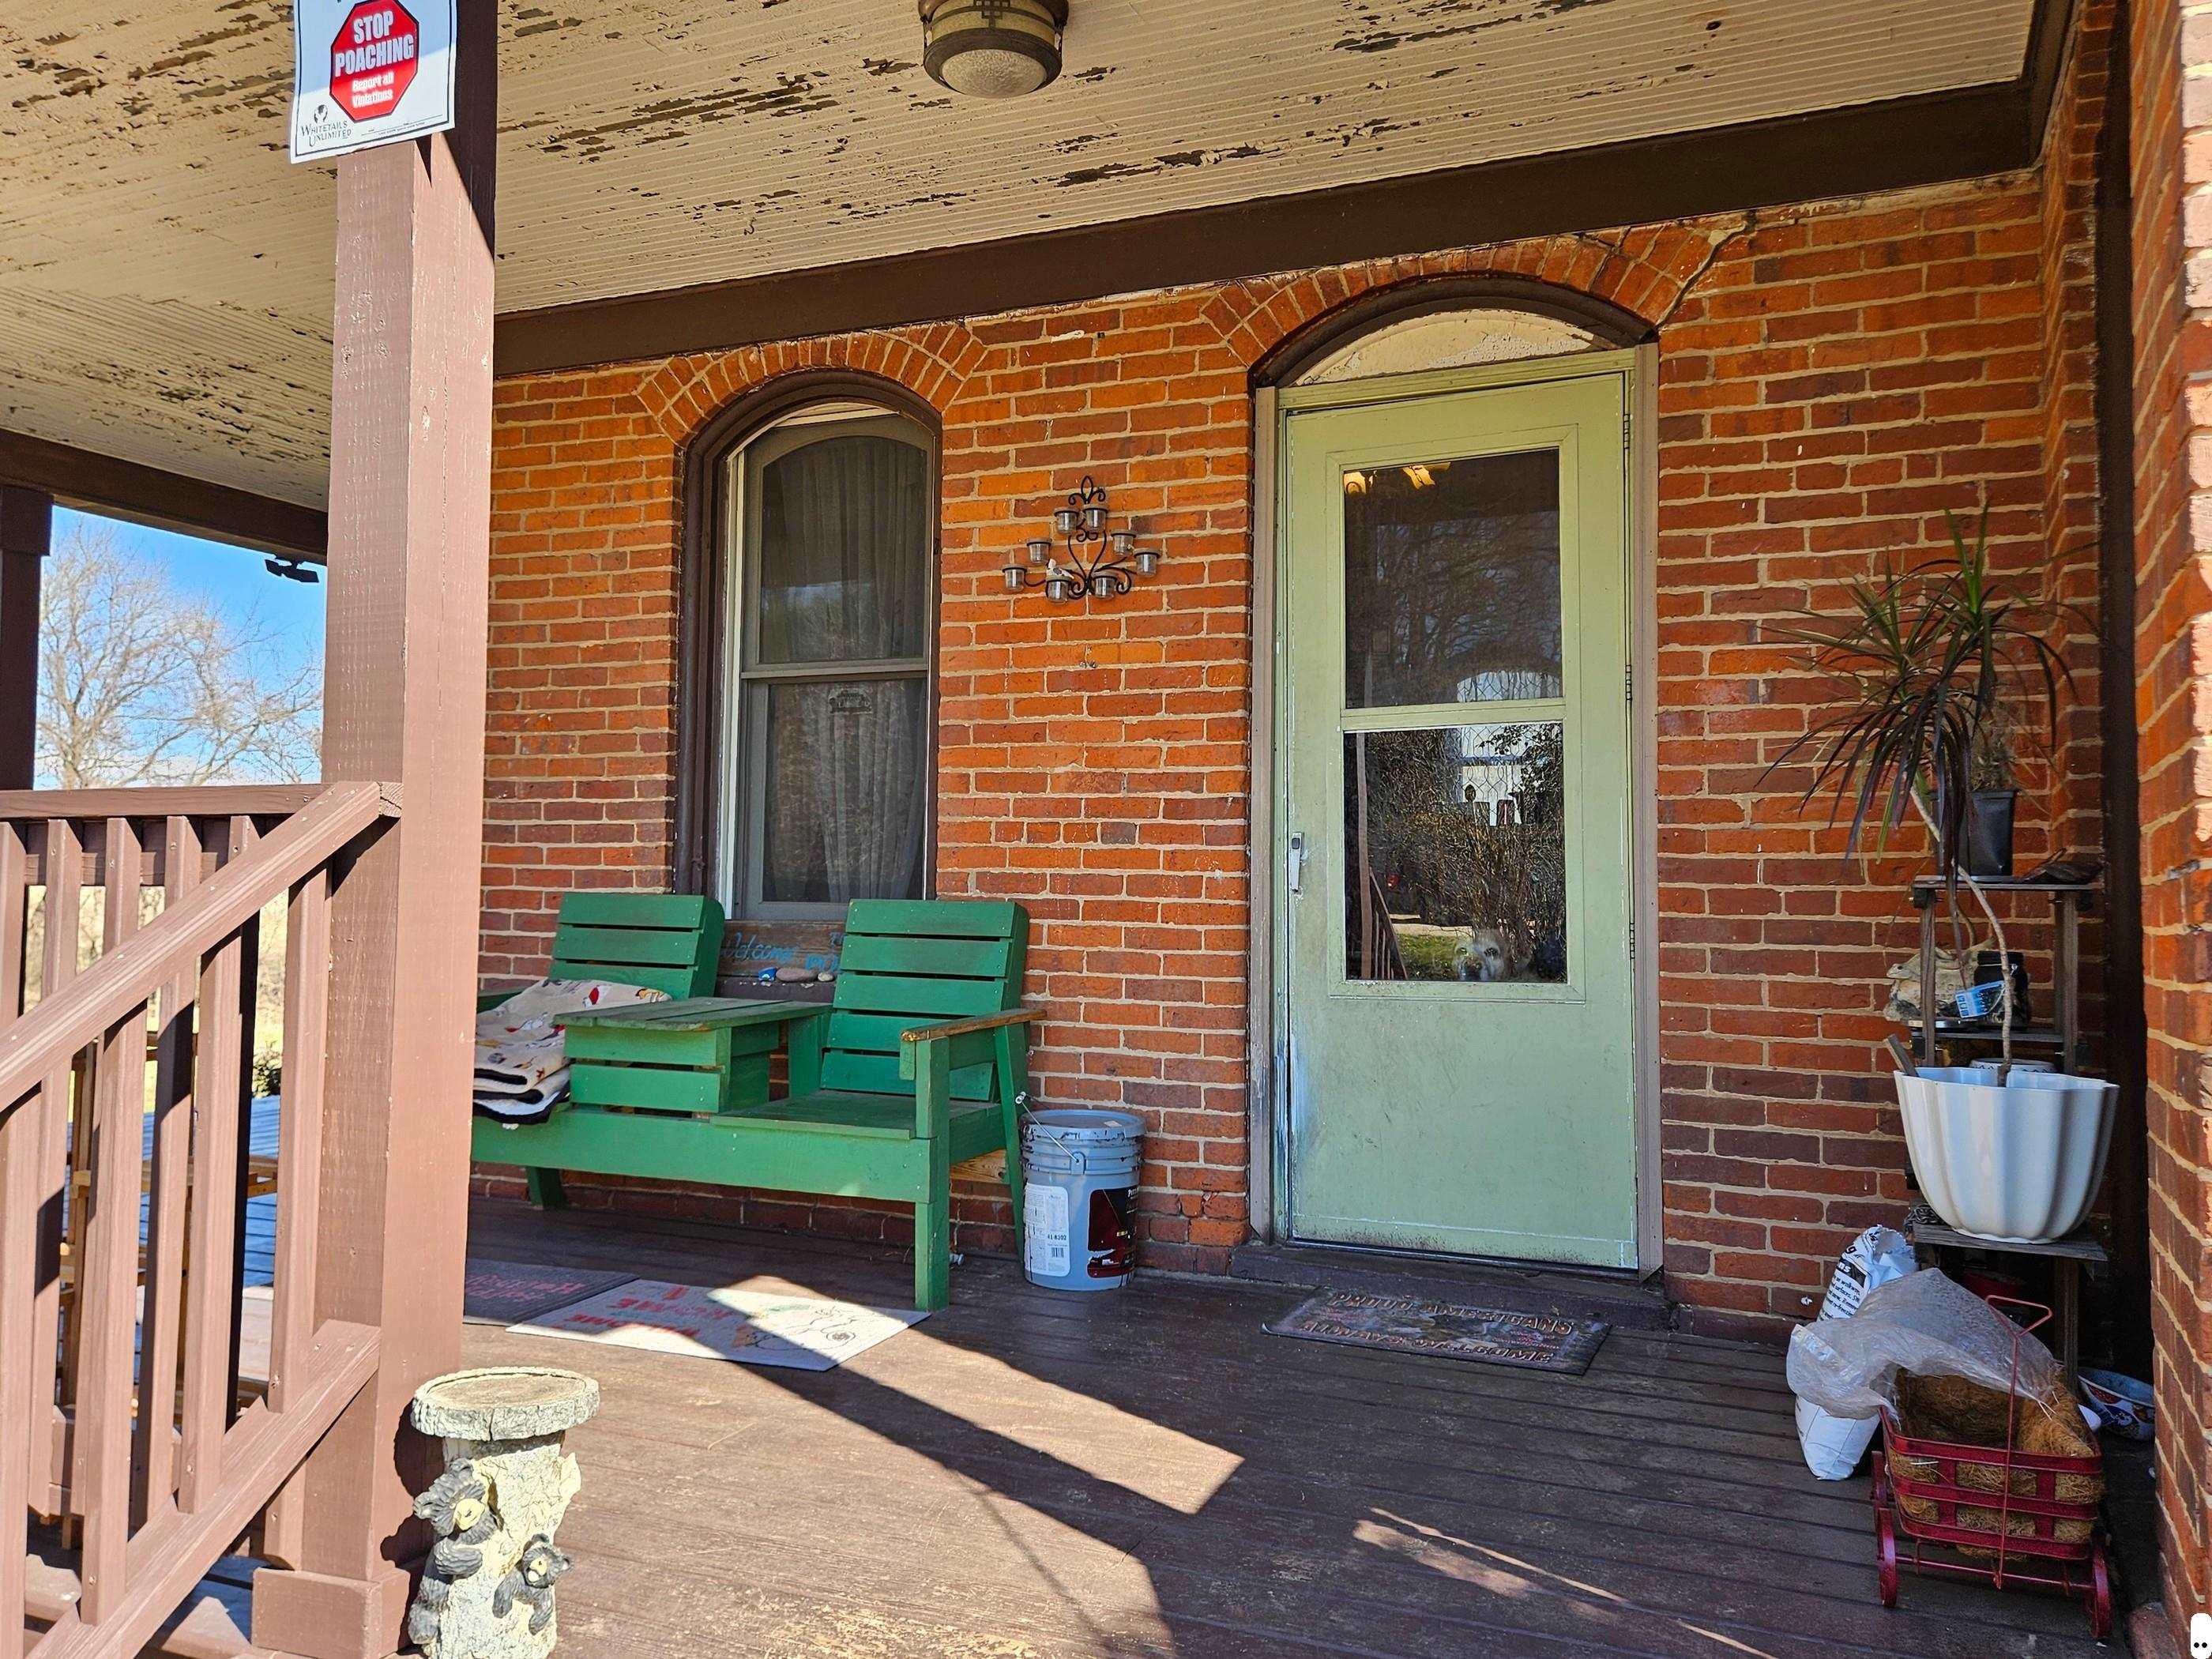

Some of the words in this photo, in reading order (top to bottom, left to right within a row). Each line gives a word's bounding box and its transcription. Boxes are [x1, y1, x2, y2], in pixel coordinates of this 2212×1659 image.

[354, 10, 394, 44] STOP
[334, 34, 414, 77] POACHING
[352, 74, 382, 92] Report
[352, 89, 393, 109] Violations
[309, 129, 352, 147] UNLIMITED
[1327, 1291, 1413, 1311] PROUD
[1423, 1304, 1574, 1335] AMERICANS
[1413, 1337, 1555, 1364] WELCOME
